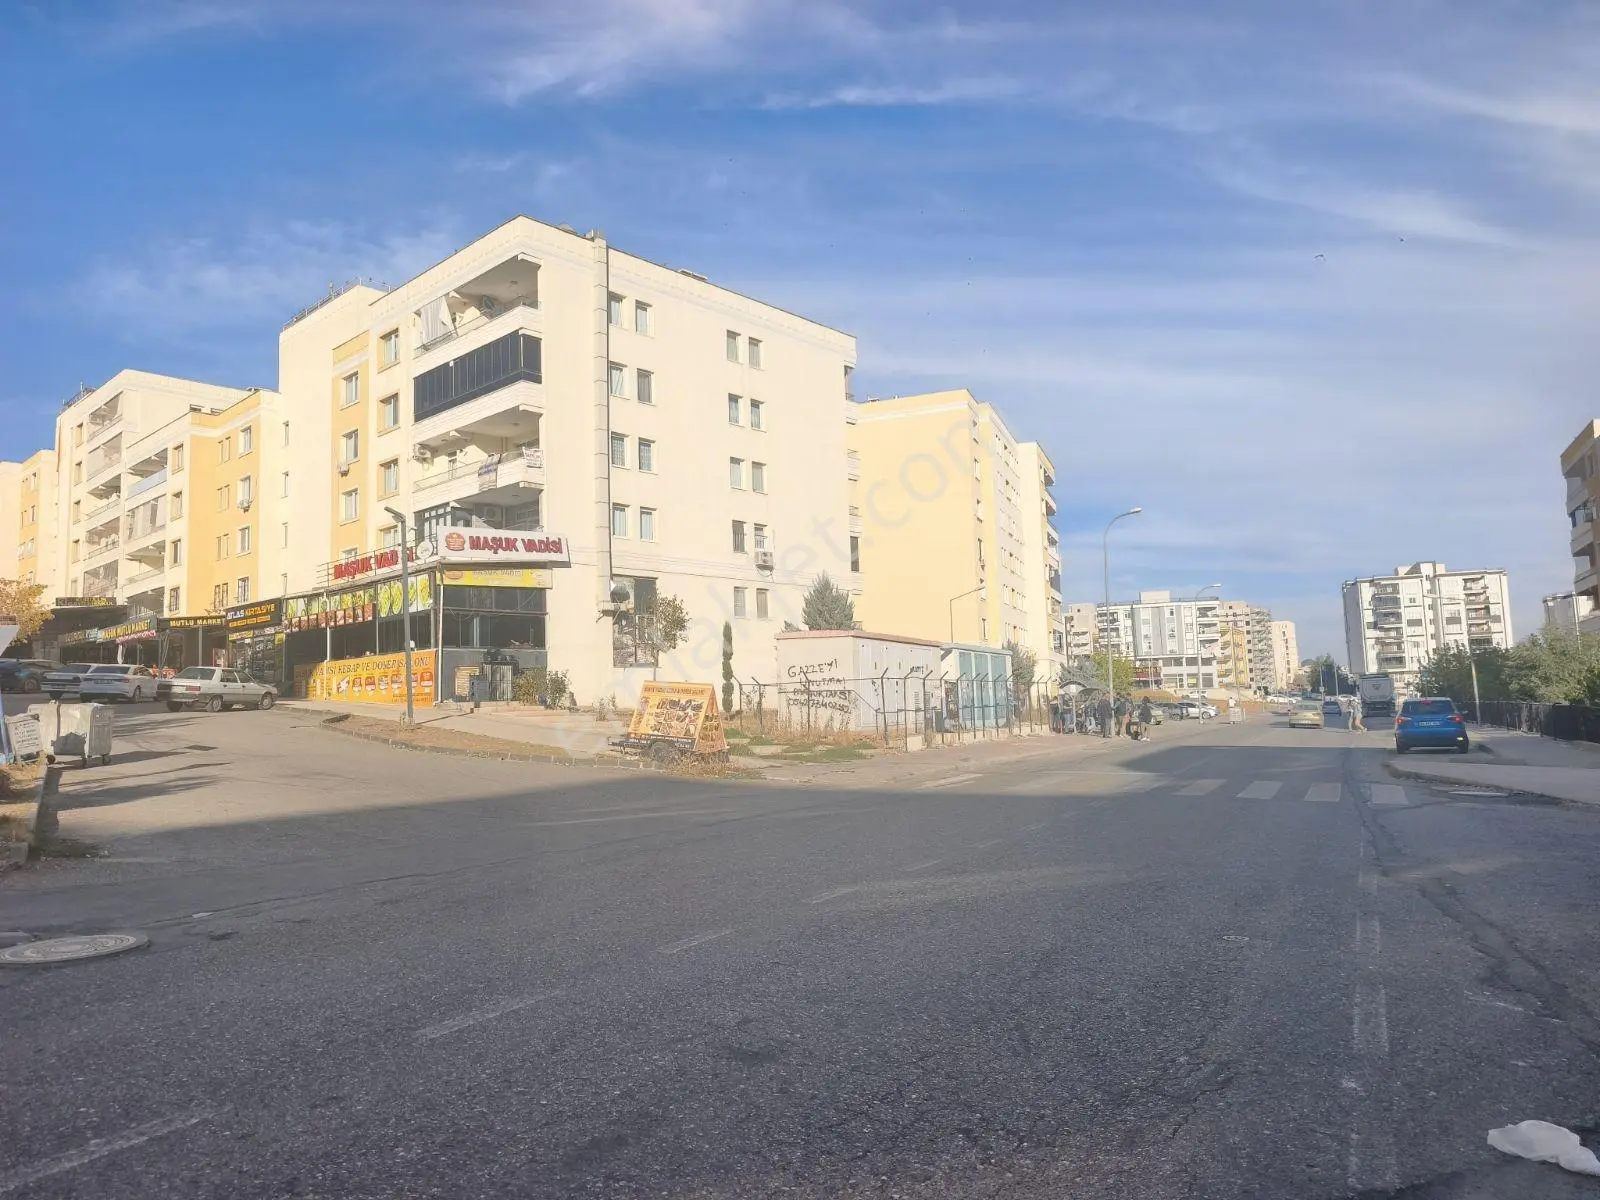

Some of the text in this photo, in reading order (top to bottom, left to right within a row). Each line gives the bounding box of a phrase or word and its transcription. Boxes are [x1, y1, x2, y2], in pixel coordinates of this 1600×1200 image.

[468, 535, 563, 554] MAŞUK VADİSİ
[334, 556, 373, 579] MAŞUK
[226, 609, 245, 620] ATLAS
[169, 619, 195, 627] MUTLU
[197, 618, 225, 626] MARKET
[361, 660, 371, 671] VE
